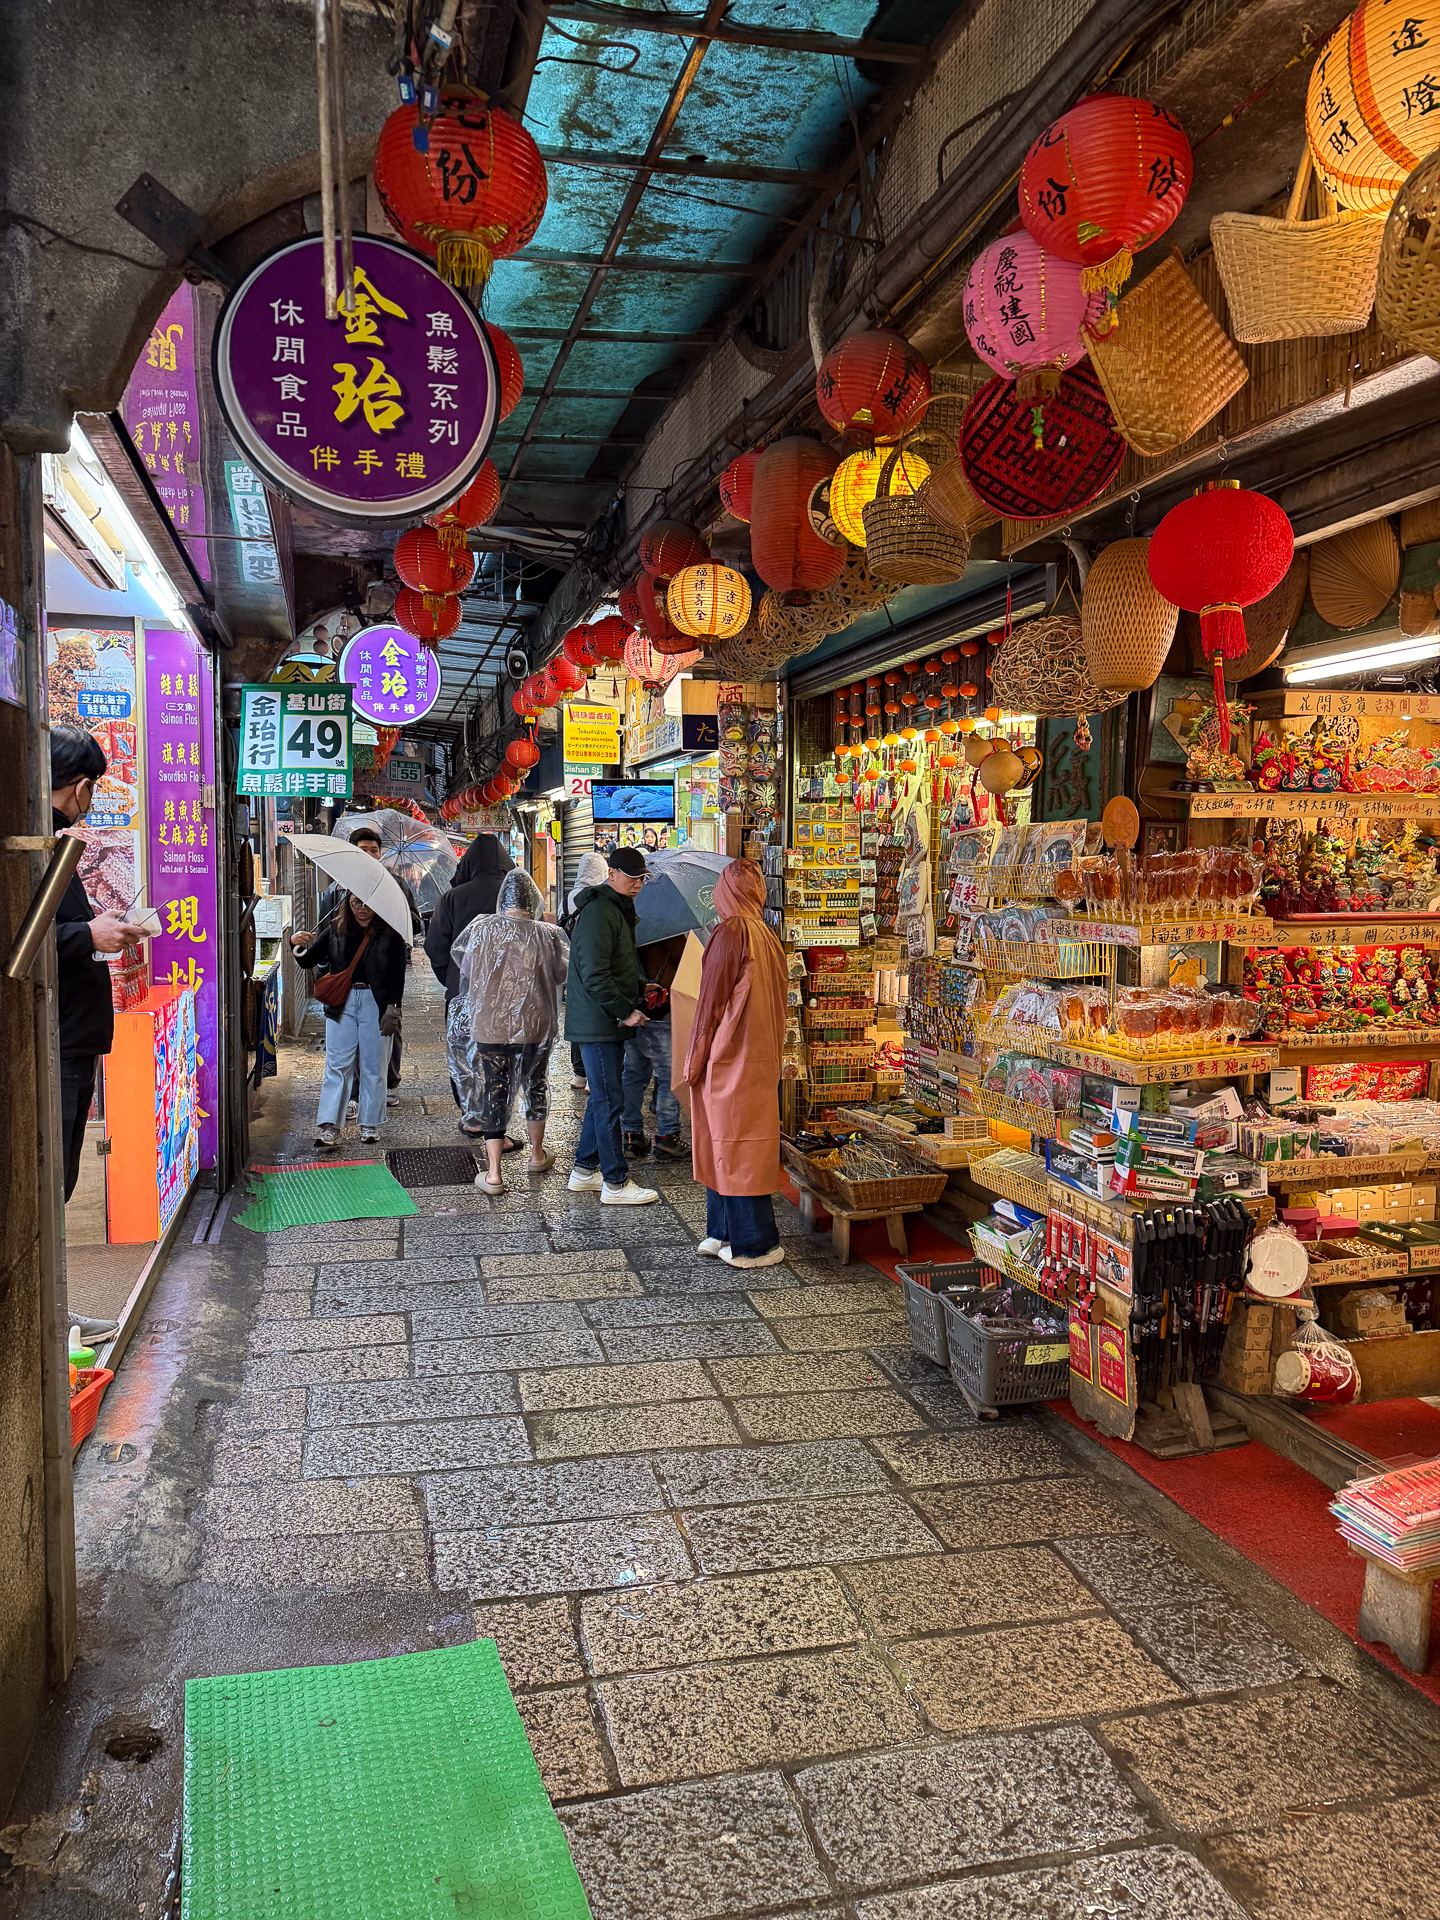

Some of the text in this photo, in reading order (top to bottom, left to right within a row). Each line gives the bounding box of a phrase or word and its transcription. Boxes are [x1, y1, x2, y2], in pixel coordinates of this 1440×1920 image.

[994, 246, 1036, 347] 慶祝建國
[426, 310, 459, 446] 魚鬆系列
[309, 444, 427, 479] 伴手禮
[81, 693, 127, 705] 芝麻海苔
[287, 693, 346, 711] 基山街
[373, 702, 415, 714] 伴手禮
[161, 712, 182, 724] Salmon
[287, 720, 342, 759] 49
[697, 722, 716, 742] た
[159, 769, 188, 783] Swordfish
[401, 769, 418, 780] 55
[564, 765, 589, 774] Jishan
[242, 773, 347, 794] 魚鬆伴手禮
[158, 823, 208, 847] 芝麻海苔
[164, 851, 204, 863] Salmon Floss
[1308, 928, 1350, 943] 福祿壽
